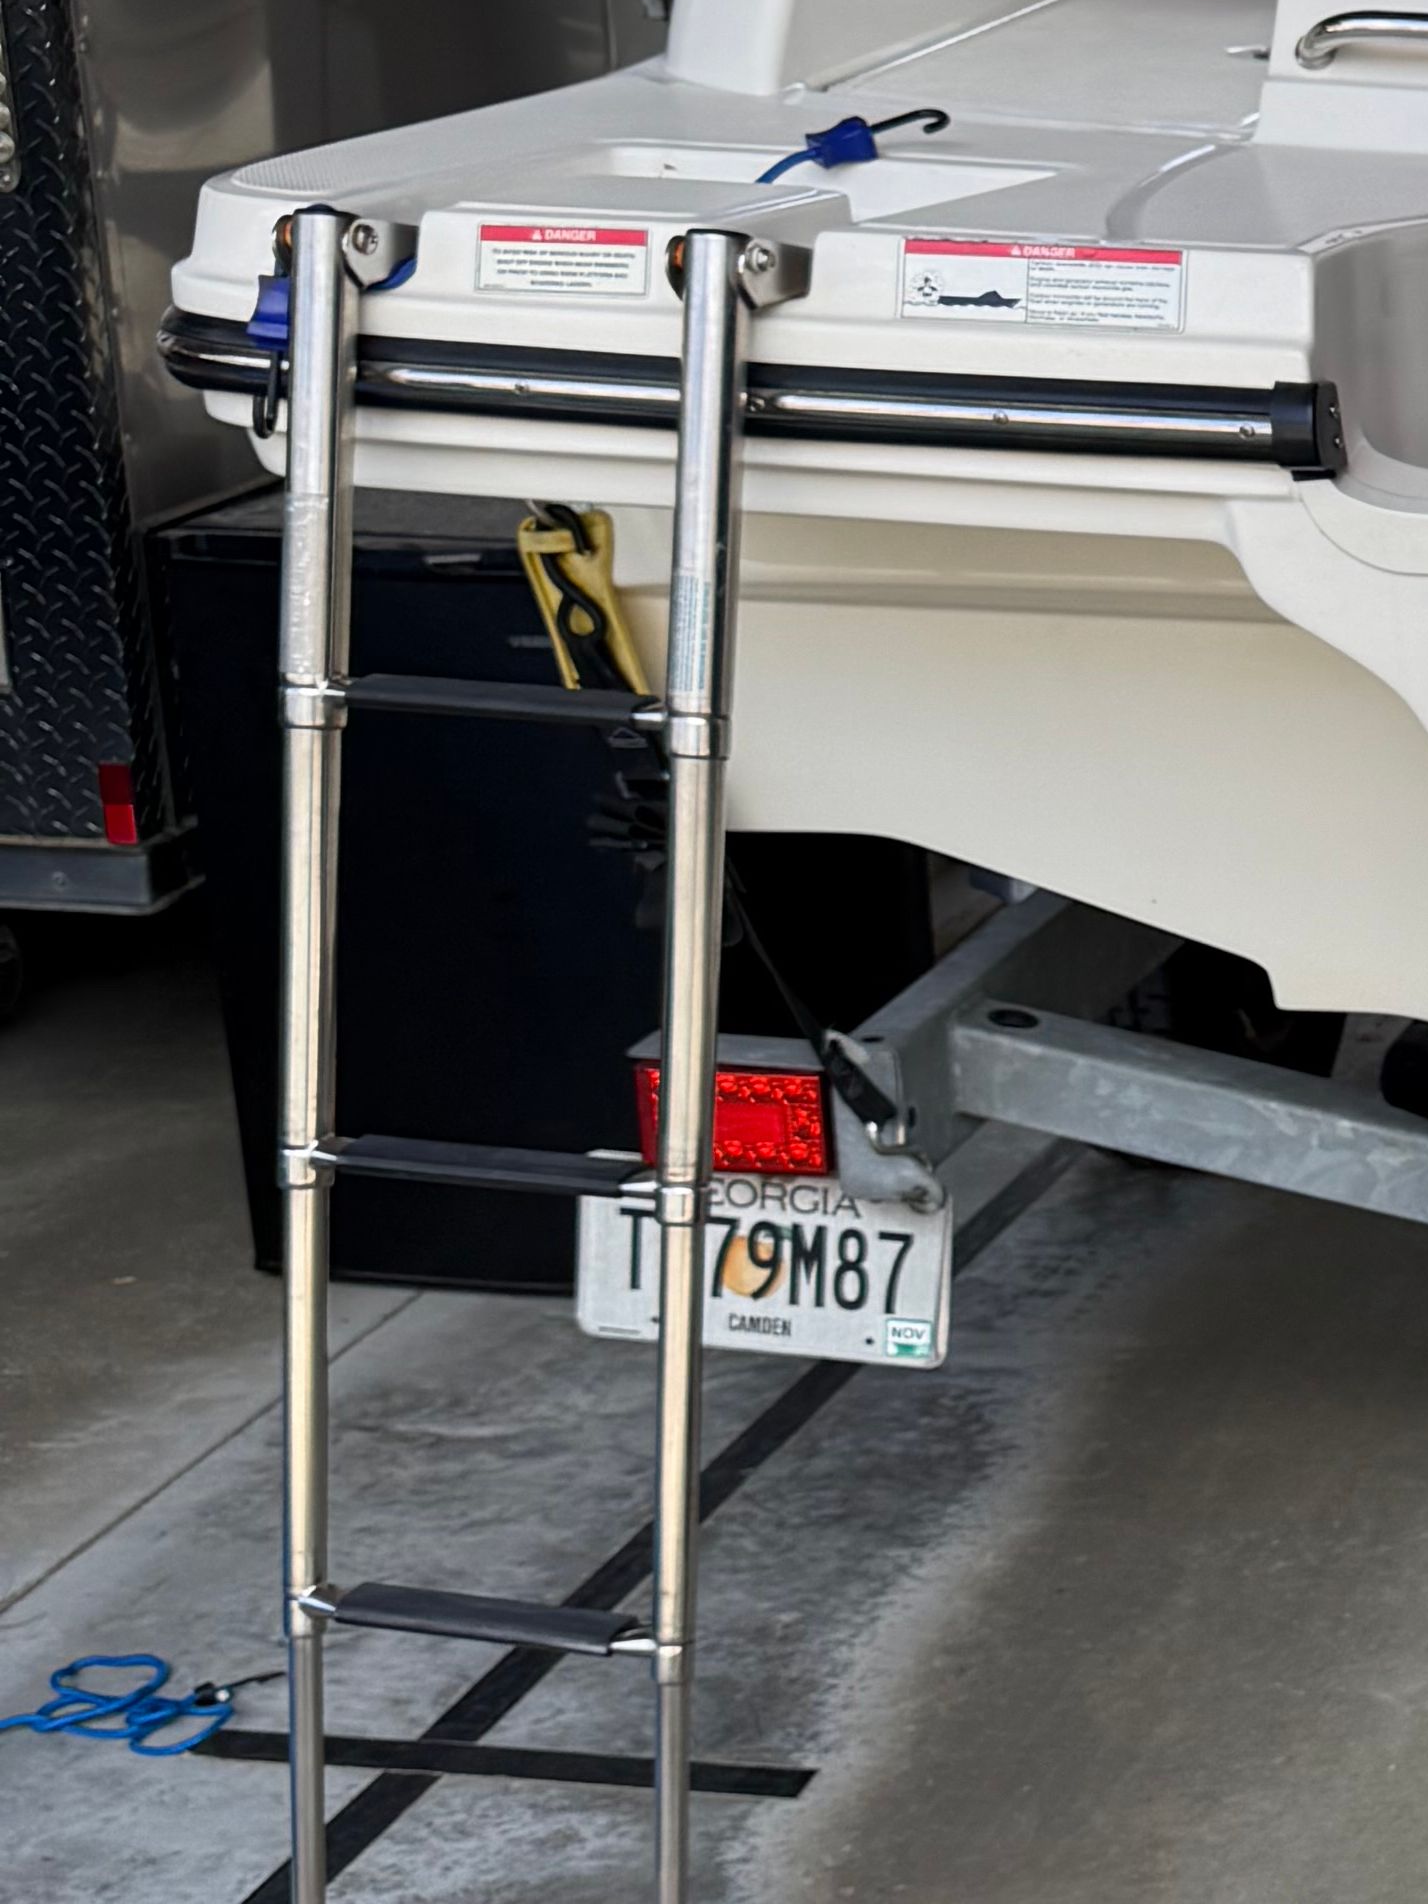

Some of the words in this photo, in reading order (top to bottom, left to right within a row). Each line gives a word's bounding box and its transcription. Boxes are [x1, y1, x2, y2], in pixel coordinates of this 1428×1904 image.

[544, 229, 597, 242] DANGER
[1023, 245, 1076, 259] DANGER
[706, 1177, 862, 1219] EORGIA
[619, 1206, 914, 1315] T79M87
[728, 1312, 793, 1337] CAMDEN
[891, 1326, 927, 1341] NOV
